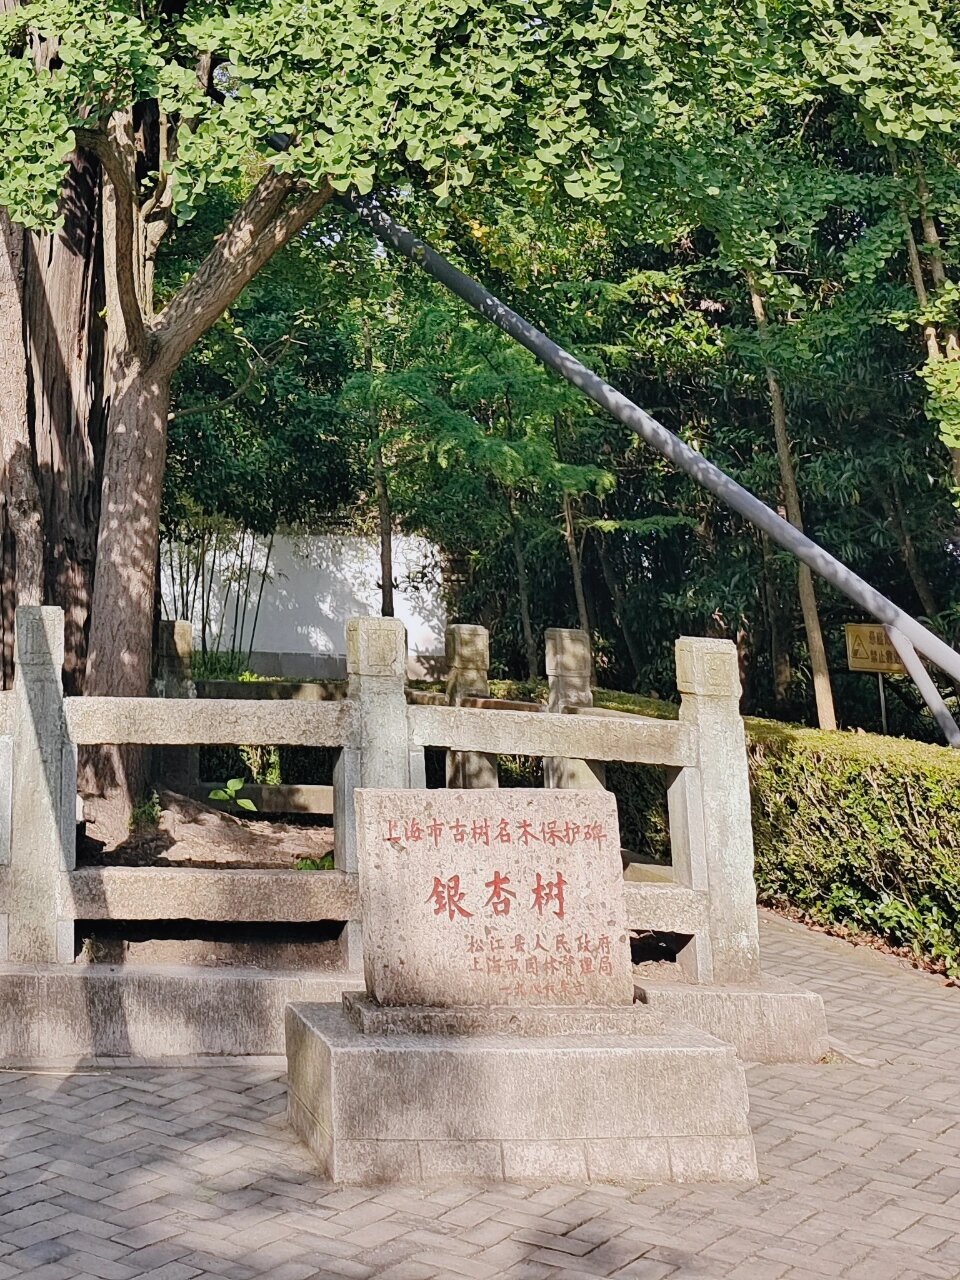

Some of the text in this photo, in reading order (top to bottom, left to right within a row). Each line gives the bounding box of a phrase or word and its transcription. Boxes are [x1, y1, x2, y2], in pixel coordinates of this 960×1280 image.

[383, 817, 608, 850] 上海市古树名木保护碑
[425, 870, 569, 922] 银杏树
[466, 933, 613, 955] 松江县人民政府
[468, 954, 614, 978] 上海市园林管理局
